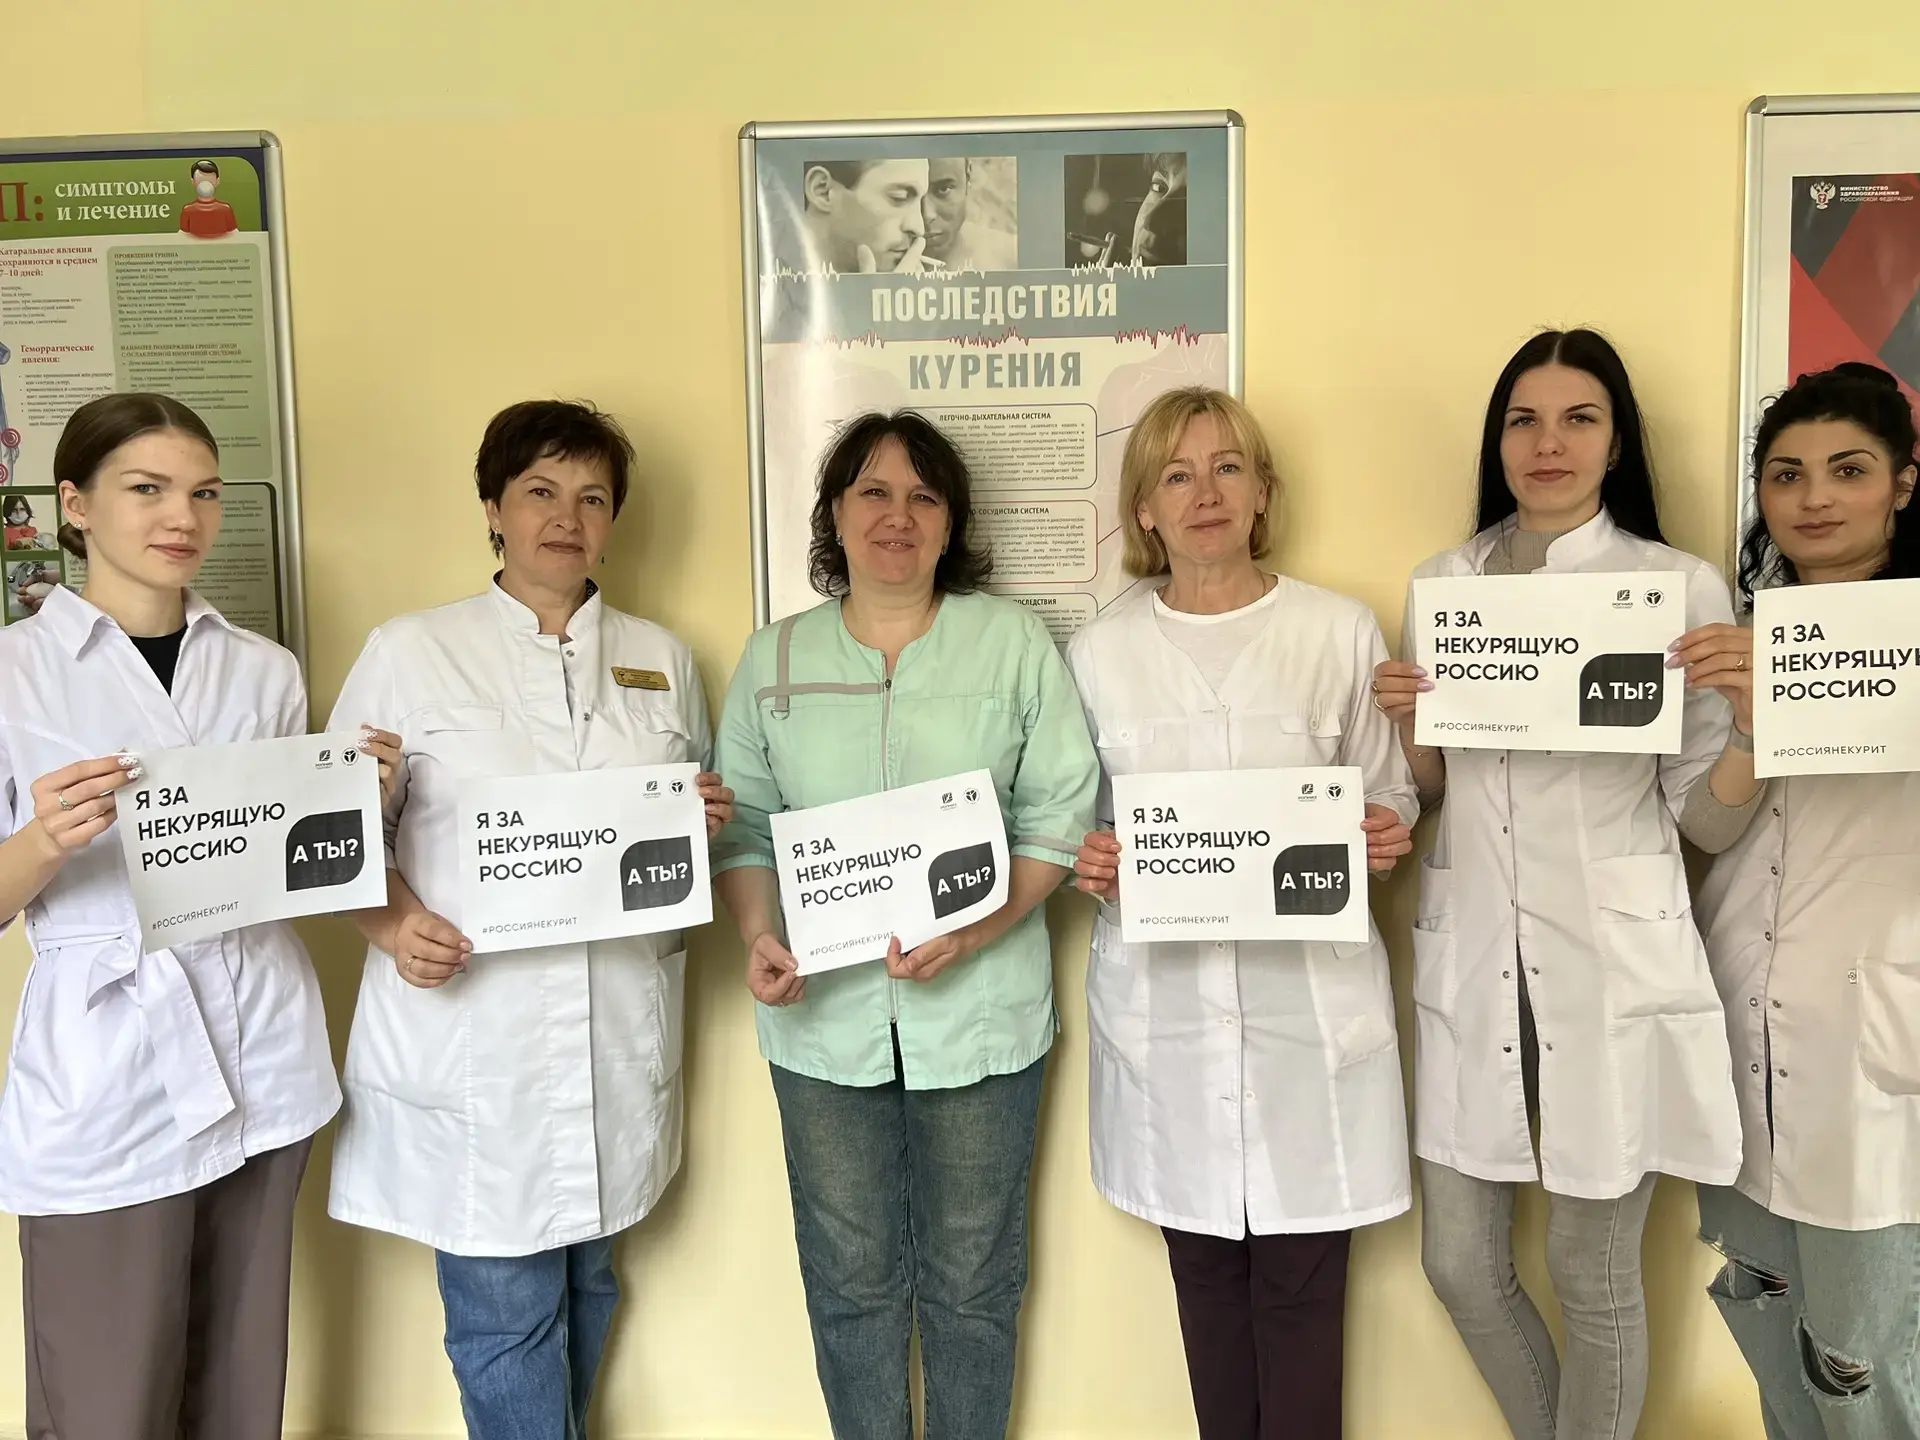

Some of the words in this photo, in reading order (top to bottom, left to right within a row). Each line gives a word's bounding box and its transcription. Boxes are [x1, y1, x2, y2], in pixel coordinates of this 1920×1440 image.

[54, 180, 176, 198] симптомы
[57, 206, 72, 221] и
[76, 203, 171, 220] лечение
[63, 257, 98, 266] среднем
[21, 269, 44, 277] дней:
[872, 283, 1119, 326] ПОСЛЕДСТВИЯ
[21, 345, 94, 355] Геморрагические
[909, 351, 1082, 390] КУРЕНИЯ
[940, 413, 1020, 421] ЛЕГОЧНО-ДЫХАТЕЛЬНАЯ
[1434, 611, 1447, 628] Я
[1454, 611, 1482, 627] ЗА
[1771, 626, 1785, 644] Я
[1793, 623, 1825, 643] ЗА
[1435, 637, 1579, 657] НЕКУРЯЩУЮ
[1435, 664, 1539, 681] РОССИЮ
[1586, 682, 1604, 700] А
[1609, 681, 1658, 700] ТЫ?
[1772, 678, 1896, 702] РОССИЮ
[1433, 722, 1529, 733] #РОССИЯНЕКУРИТ
[1773, 745, 1886, 757] #РОССИЯНЕКУРИТ
[135, 790, 150, 811] Я
[158, 786, 189, 807] ЗА
[137, 802, 286, 841] НЕКУРЯЩУЮ
[476, 812, 490, 829] Я
[496, 810, 524, 828] ЗА
[1133, 808, 1146, 824] Я
[1152, 807, 1178, 823] ЗА
[478, 827, 617, 856] НЕКУРЯЩУЮ
[792, 843, 805, 859] Я
[810, 837, 836, 856] ЗА
[1135, 830, 1270, 850] НЕКУРЯЩУЮ
[141, 835, 248, 872] РОССИЮ
[292, 846, 309, 864] А
[312, 838, 359, 861] ТЫ?
[479, 857, 583, 882] РОССИЮ
[627, 868, 643, 886] А
[646, 861, 688, 884] ТЫ?
[795, 843, 922, 884] НЕКУРЯЩУЮ
[1136, 857, 1235, 875] РОССИЮ
[936, 878, 951, 896] А
[953, 865, 991, 891] ТЫ?
[1280, 873, 1296, 890] А
[1300, 871, 1345, 889] ТЫ?
[800, 875, 893, 908] РОССИЮ
[152, 901, 239, 931] #РОССИЯНЕКУРИТ
[482, 916, 578, 935] #РОССИЯНЕКУРИТ
[1140, 916, 1229, 925] #РОССИЯНЕКУРИТ
